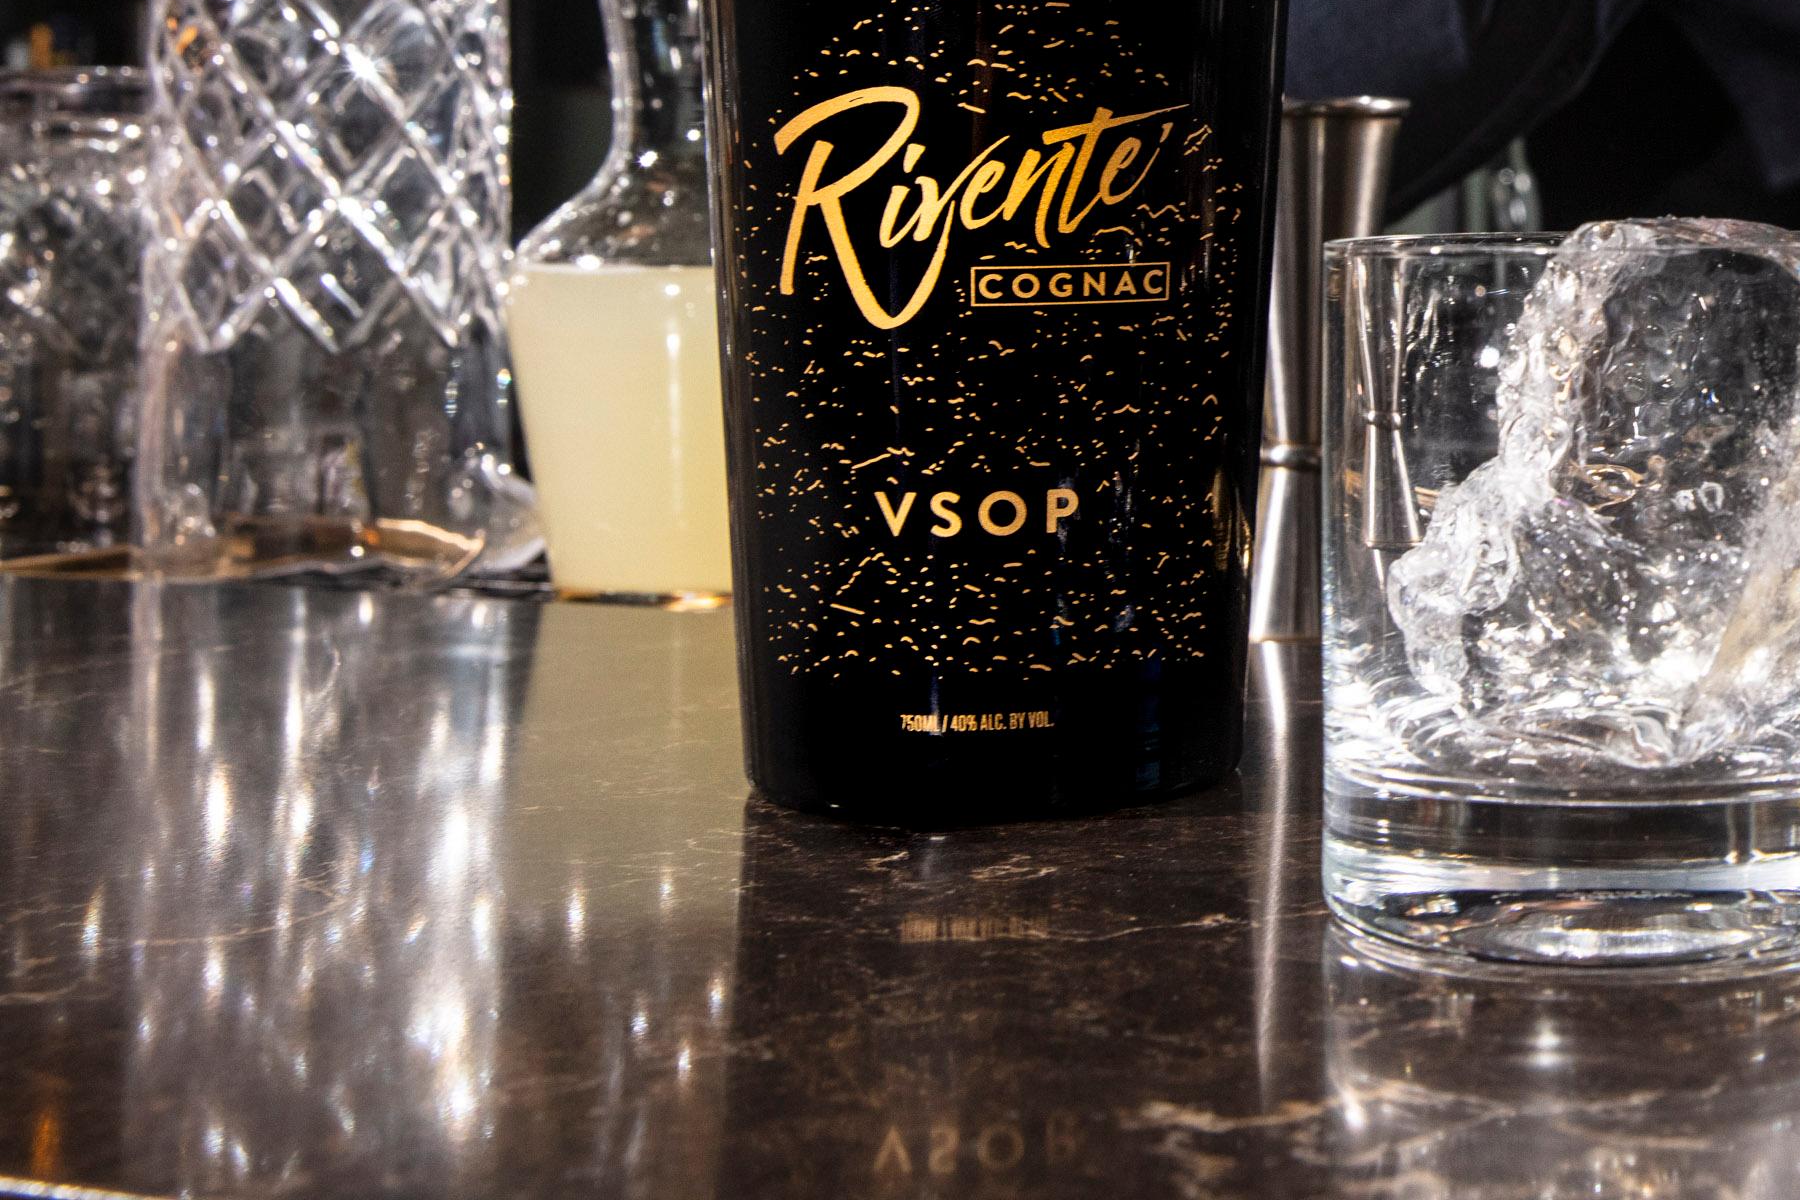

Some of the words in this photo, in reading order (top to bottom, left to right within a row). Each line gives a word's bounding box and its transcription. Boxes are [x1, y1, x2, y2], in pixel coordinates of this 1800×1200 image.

[977, 268, 1165, 300] COGNAC
[874, 490, 1080, 538] VSOP
[900, 714, 941, 733] 750ML
[950, 714, 977, 732] 40%
[979, 713, 1007, 731] ALC.
[1009, 712, 1026, 730] BY
[1027, 711, 1055, 729] VOL.
